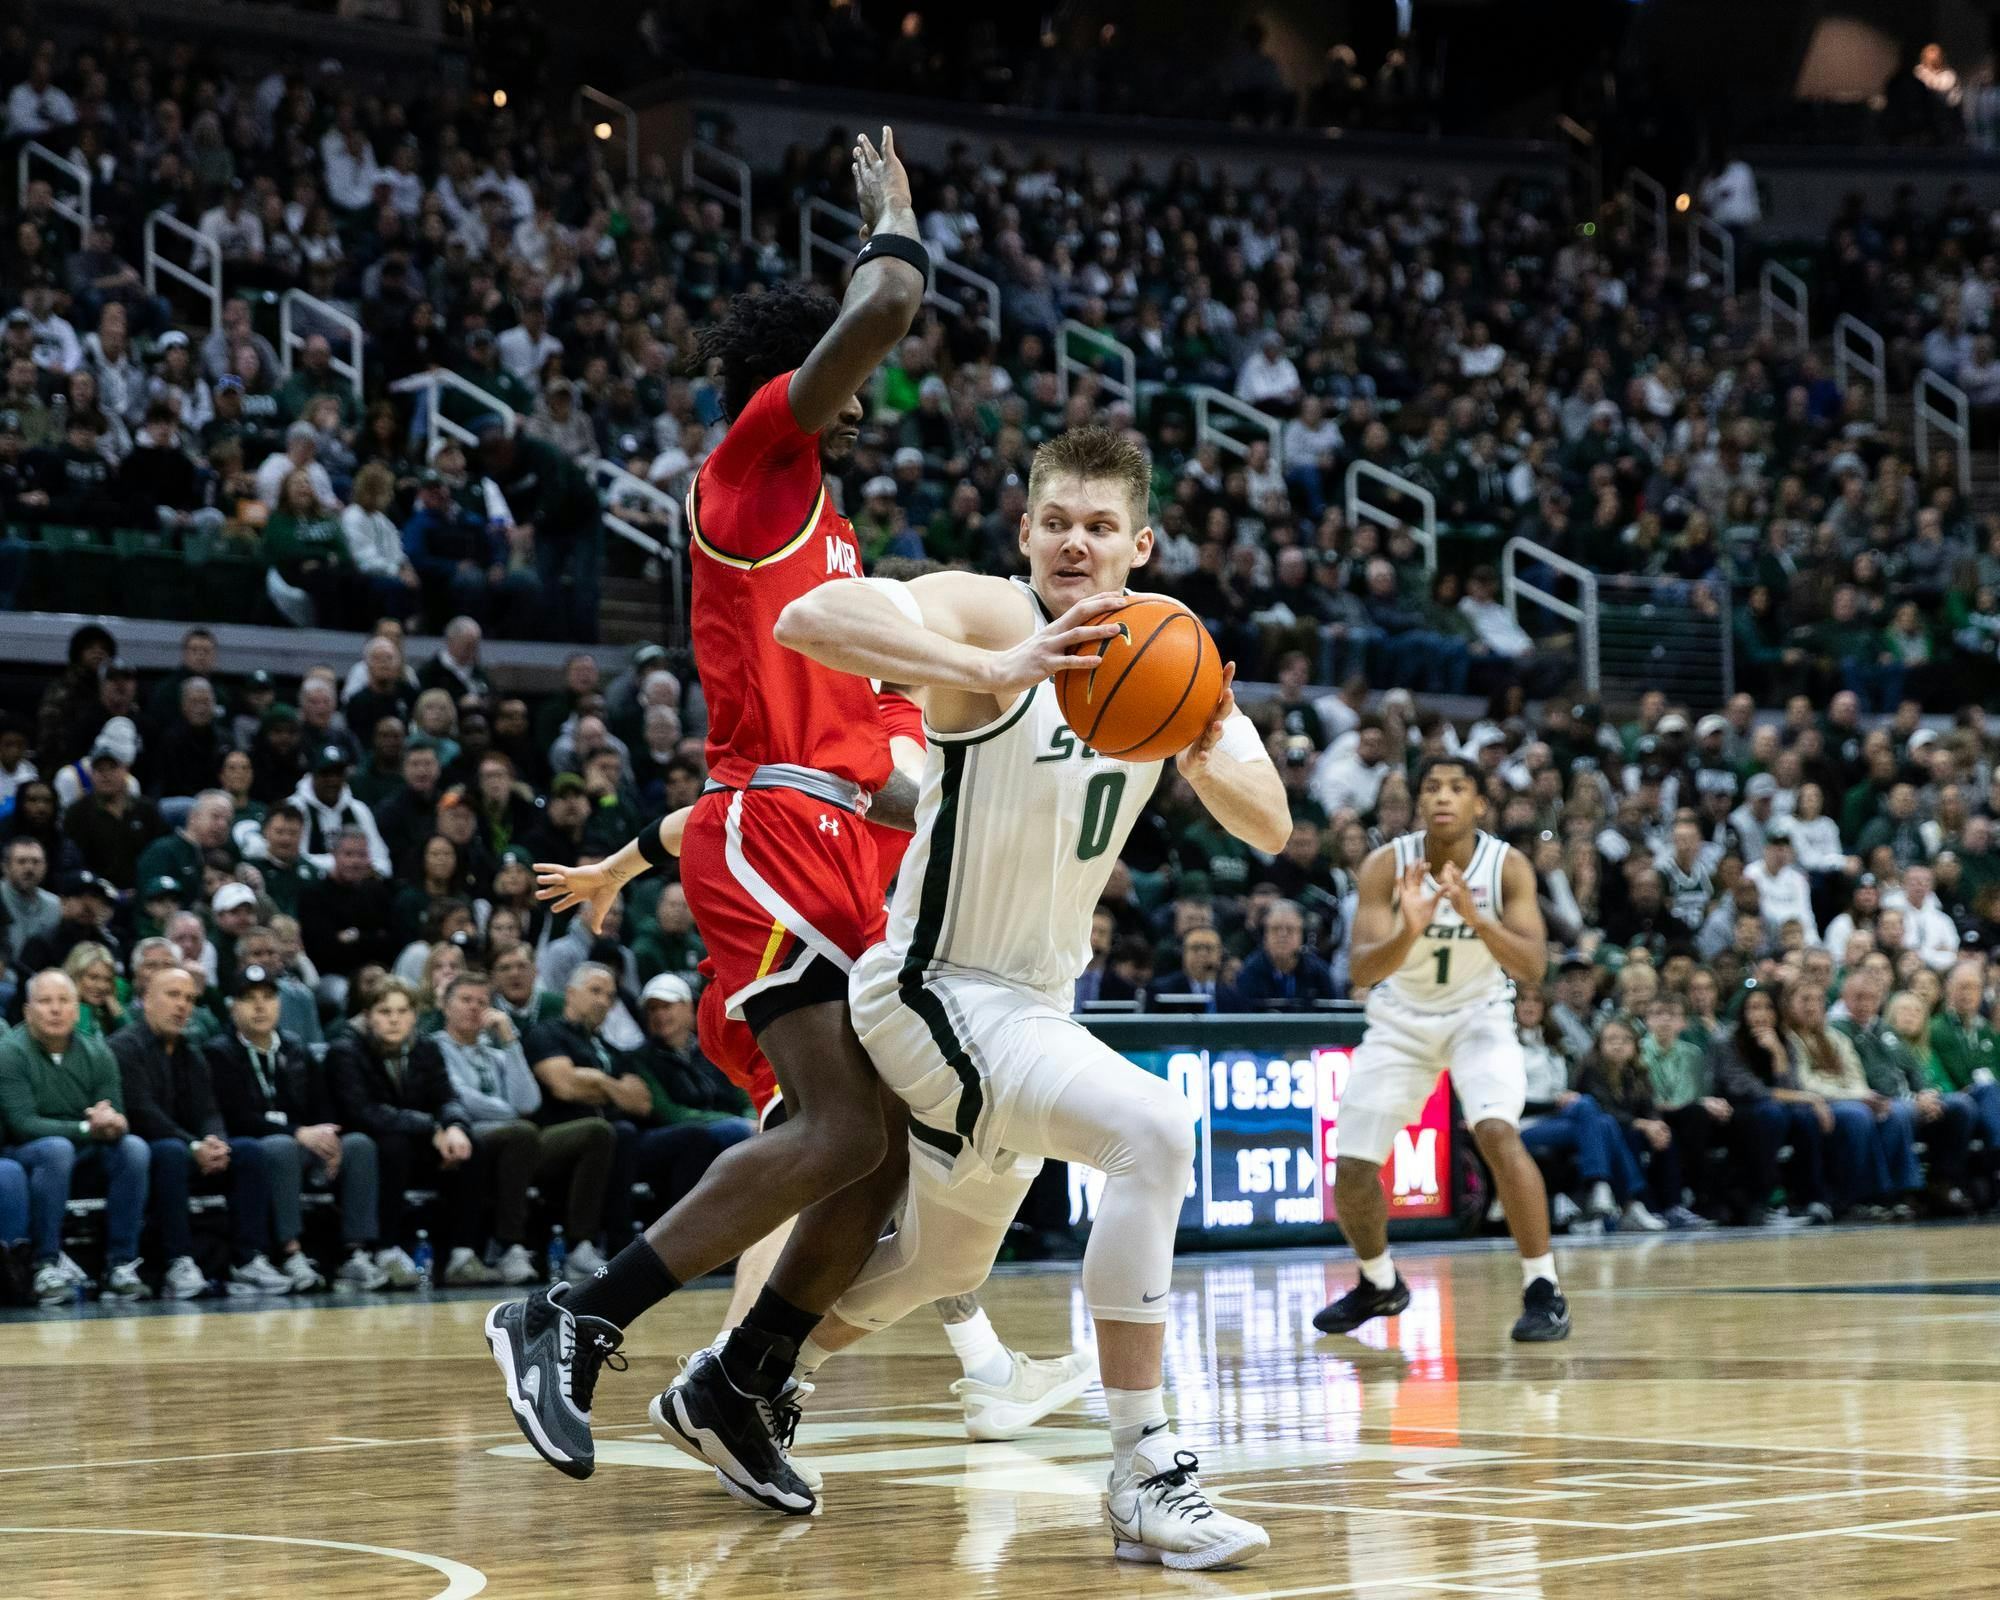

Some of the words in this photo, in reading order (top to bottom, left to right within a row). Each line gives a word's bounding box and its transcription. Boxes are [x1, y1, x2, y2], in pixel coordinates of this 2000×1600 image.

[1074, 769, 1127, 862] 0
[1432, 945, 1450, 984] 1
[1212, 1060, 1315, 1110] 19:33
[1236, 1148, 1291, 1193] 1ST
[1393, 1128, 1439, 1195] M
